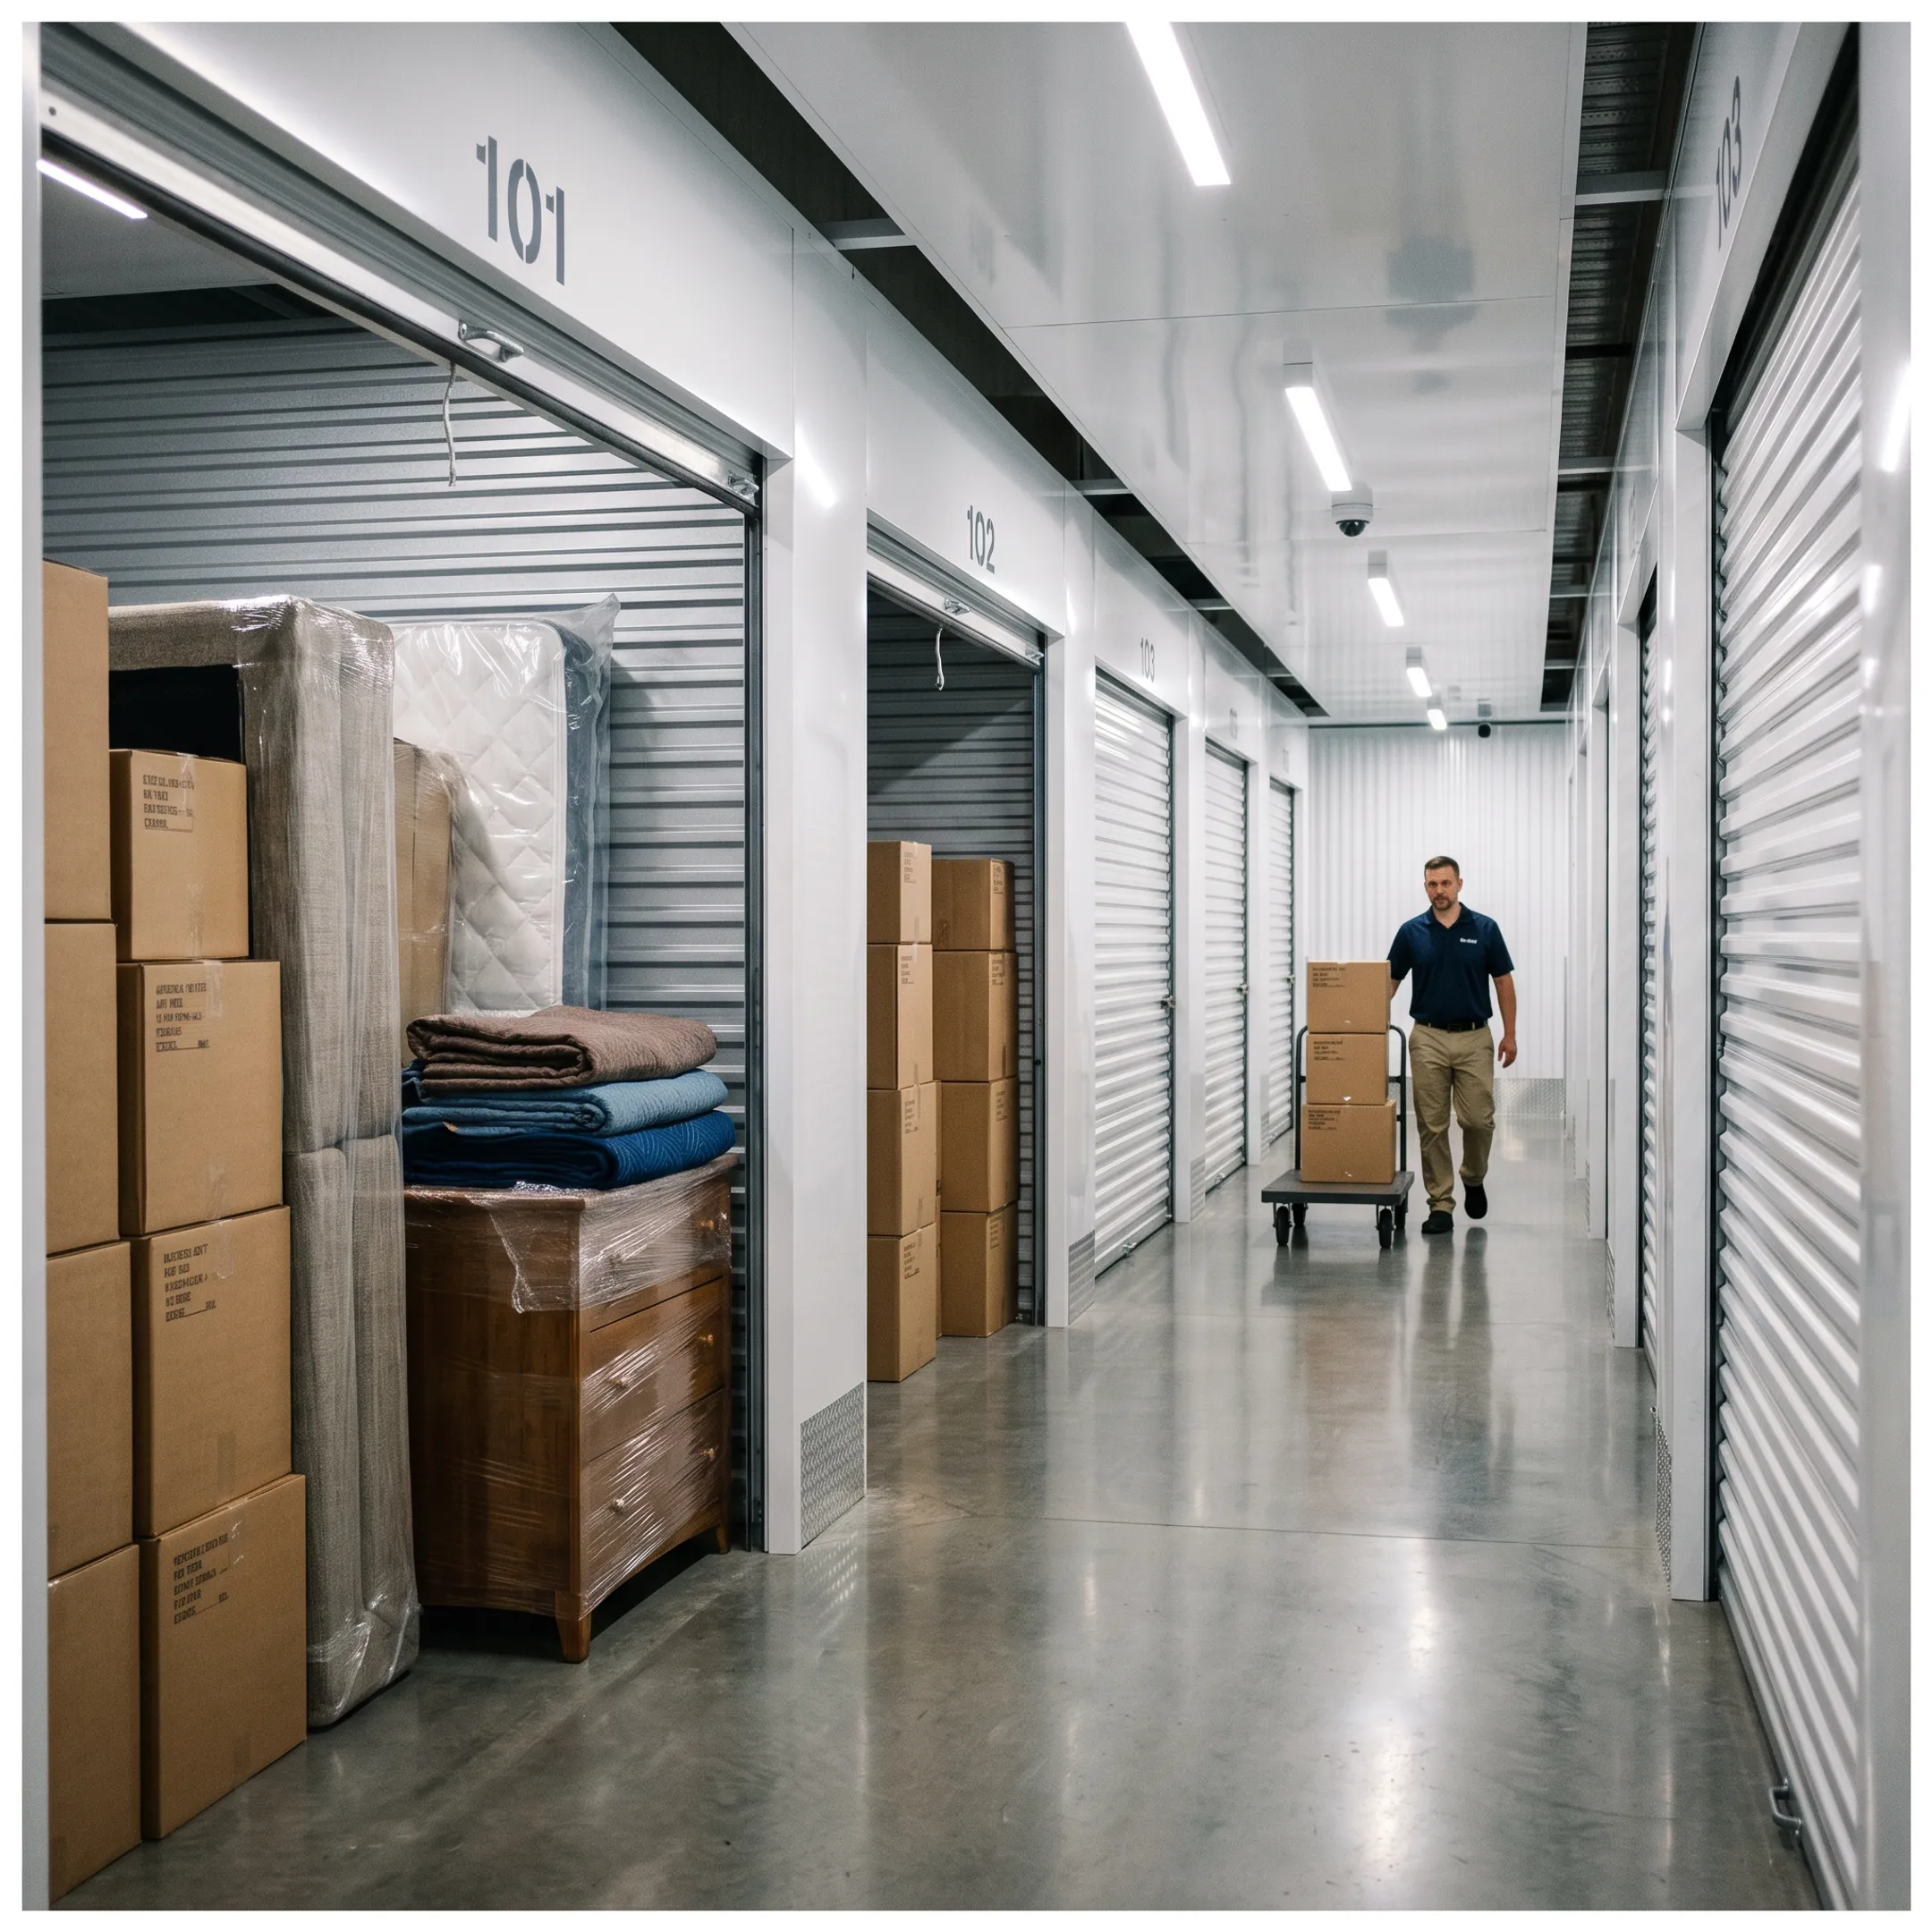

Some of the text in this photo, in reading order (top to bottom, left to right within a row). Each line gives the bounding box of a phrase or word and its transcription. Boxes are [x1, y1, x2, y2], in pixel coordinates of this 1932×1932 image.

[476, 134, 565, 286] 101
[1716, 75, 1742, 252] 103
[967, 504, 995, 574] 102
[1140, 637, 1156, 683] 103
